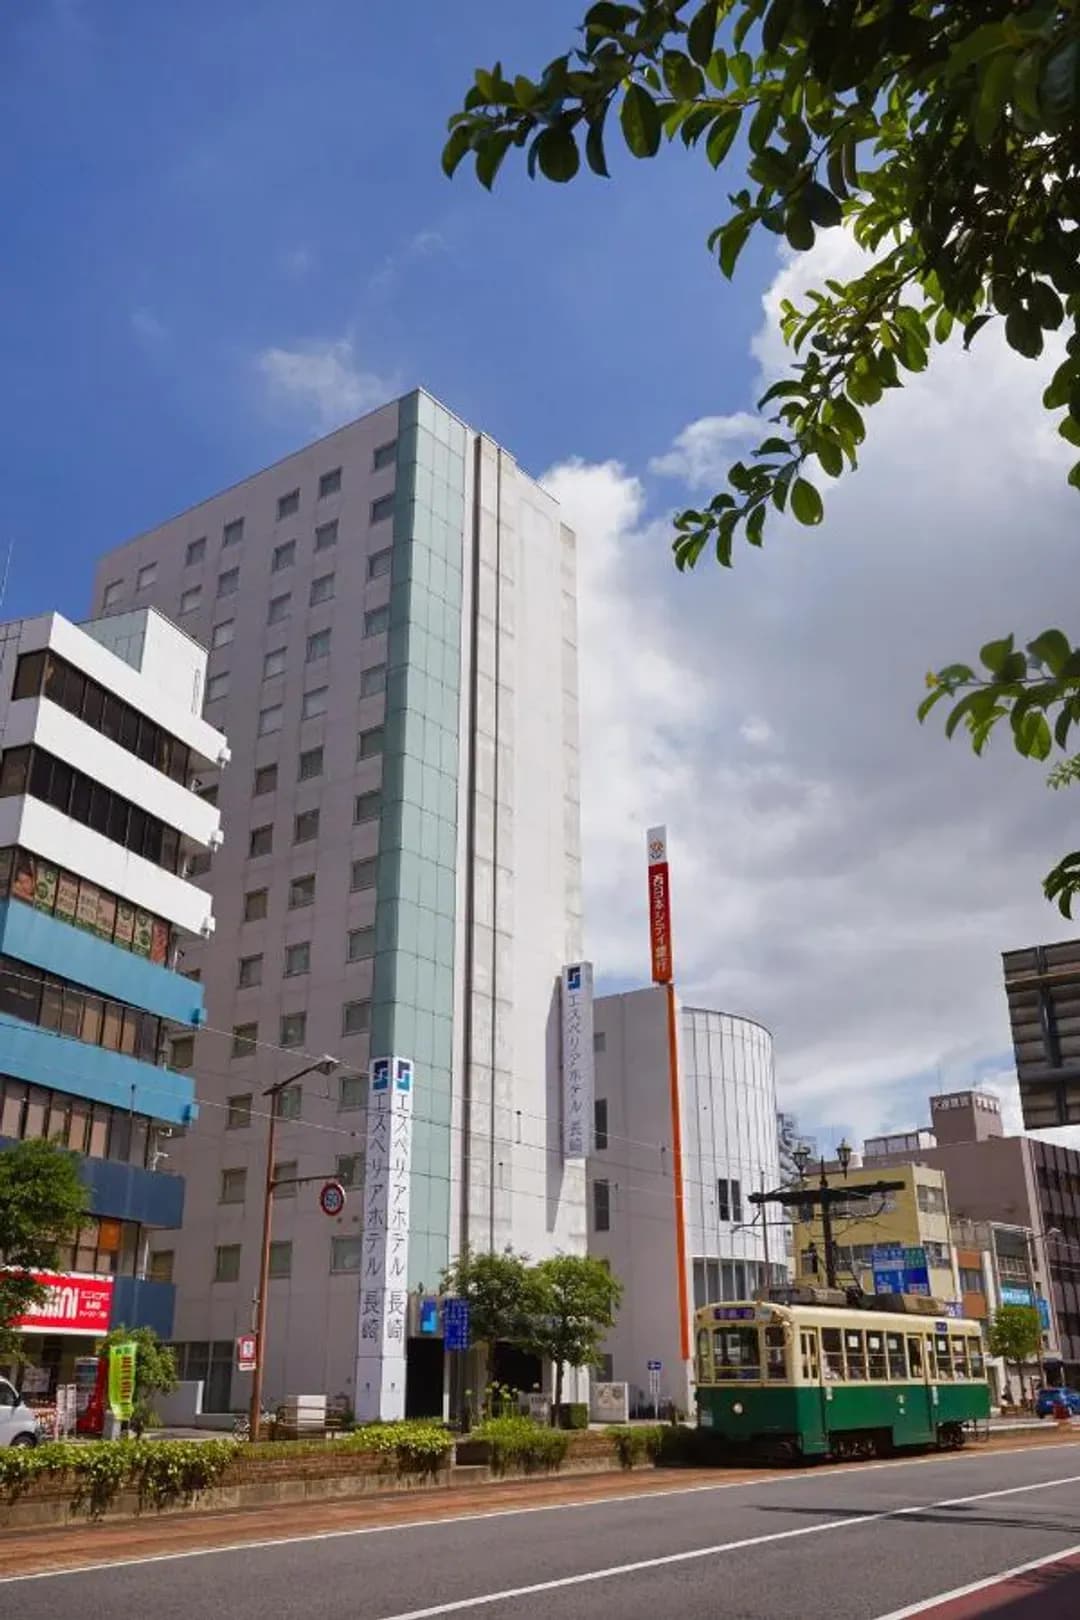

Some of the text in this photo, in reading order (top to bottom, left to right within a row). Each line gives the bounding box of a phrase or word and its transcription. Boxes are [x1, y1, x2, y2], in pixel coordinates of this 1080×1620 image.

[362, 1093, 387, 1343] エスペリアホテル 長崎
[387, 1093, 410, 1343] エスペリアホテル 長崎
